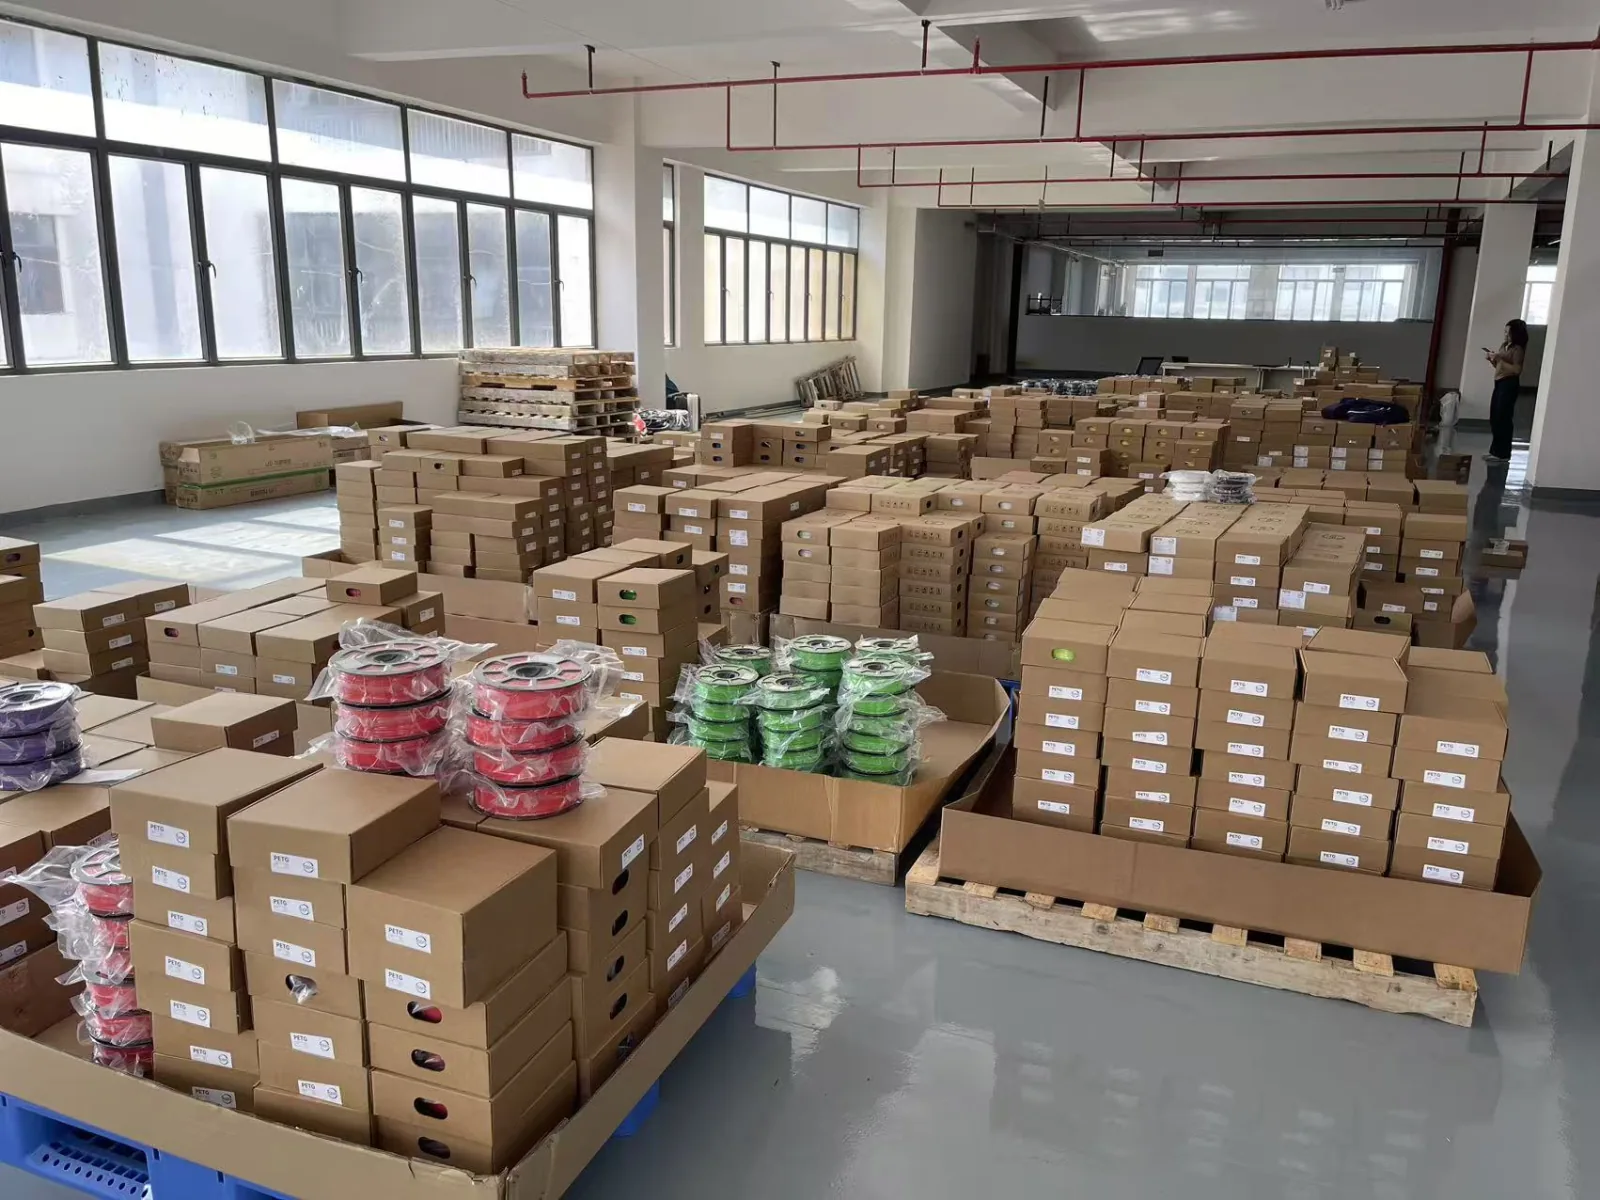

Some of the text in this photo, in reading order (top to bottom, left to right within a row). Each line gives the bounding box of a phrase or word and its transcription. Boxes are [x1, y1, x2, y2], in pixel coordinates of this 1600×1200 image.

[150, 824, 164, 832] PETG
[273, 855, 289, 863] PETG
[155, 868, 167, 877] PETG
[170, 913, 184, 921] PETG
[388, 927, 404, 936] PETG
[275, 942, 290, 950] PETG
[168, 958, 181, 968] PETG
[388, 971, 404, 981] PETG
[173, 1002, 187, 1010] PETG
[293, 1034, 308, 1042] PETG
[301, 1082, 316, 1090] PETG
[195, 1088, 210, 1096] PETG
